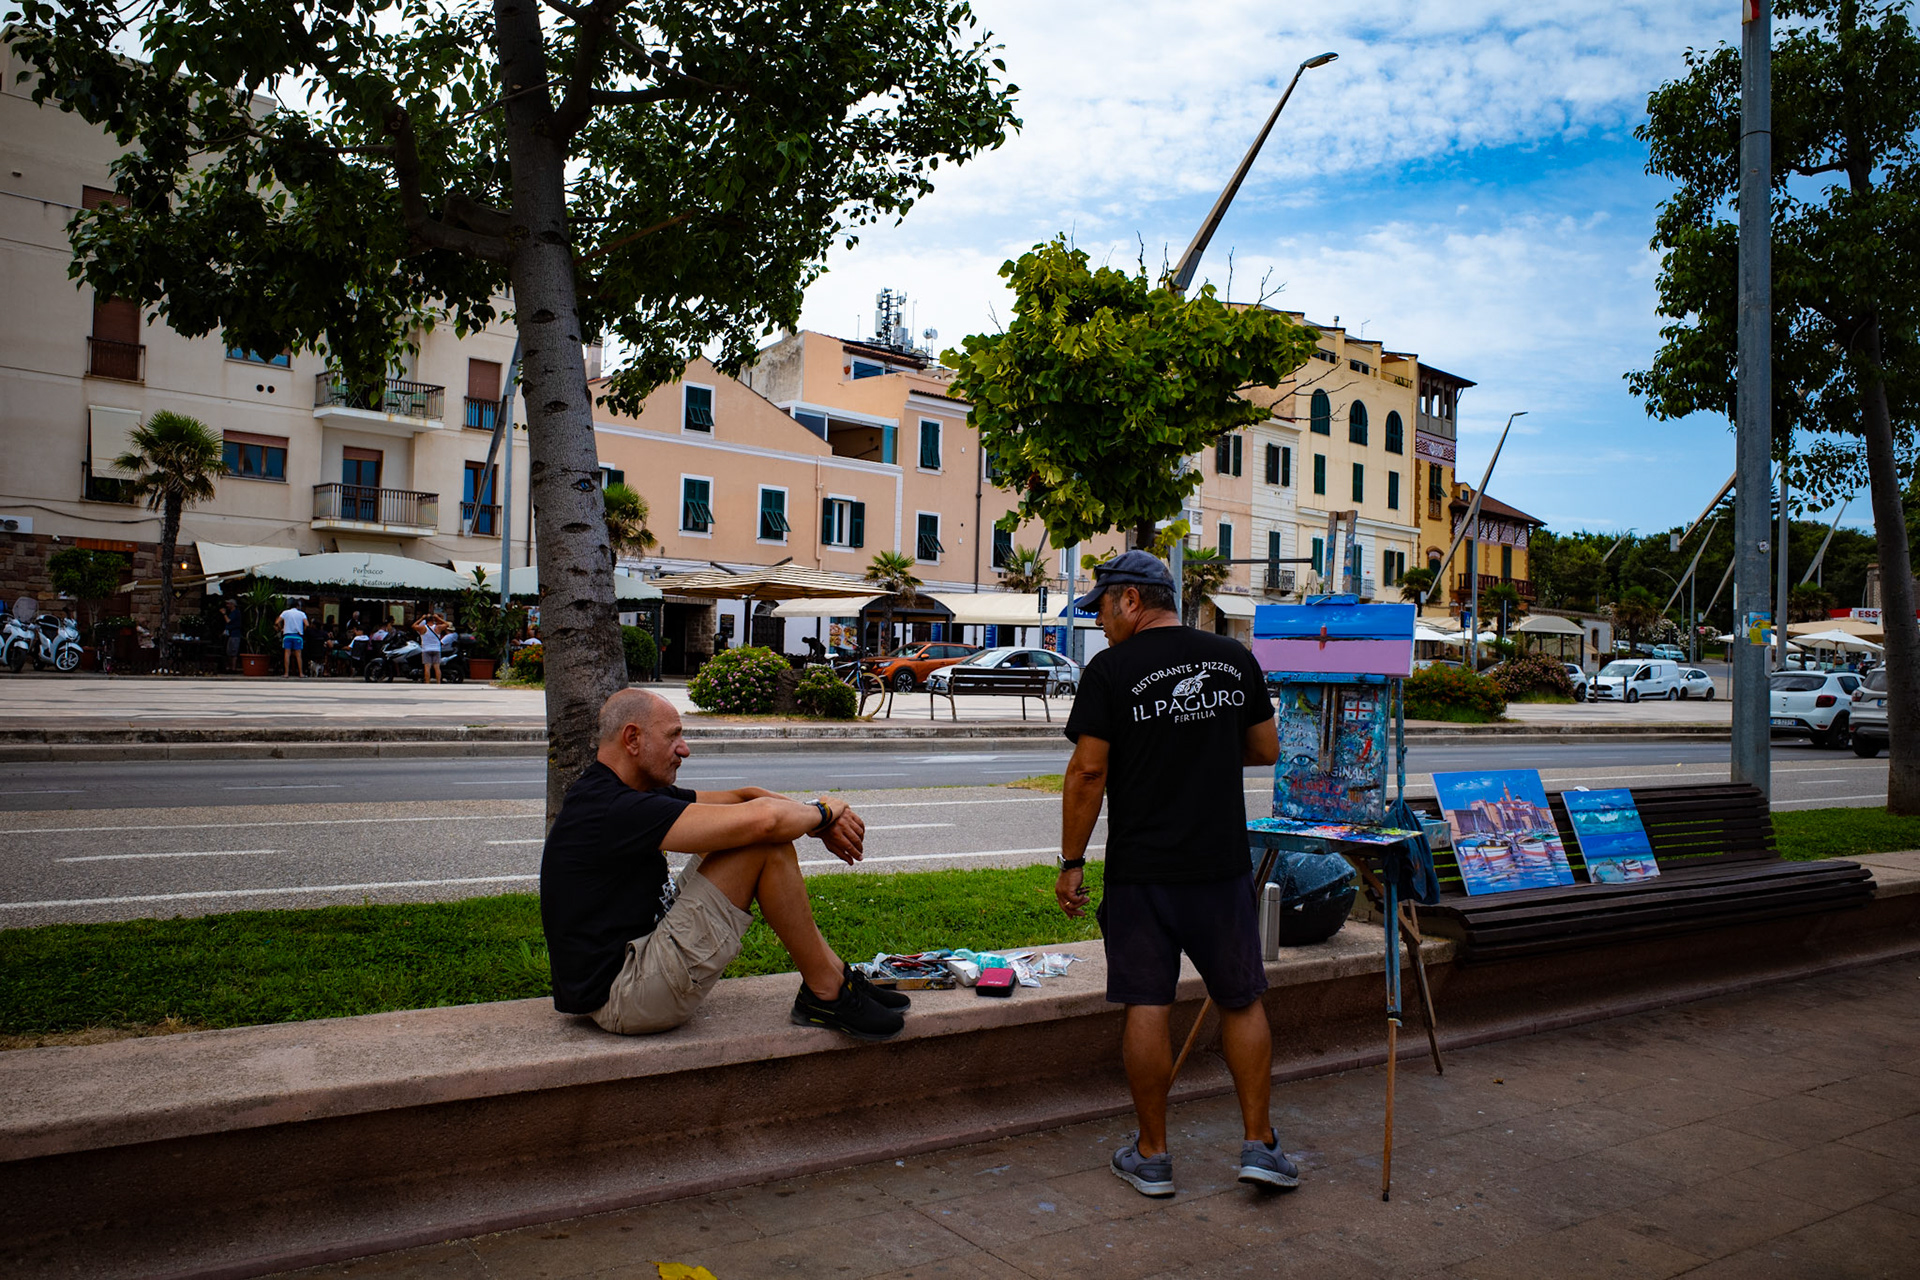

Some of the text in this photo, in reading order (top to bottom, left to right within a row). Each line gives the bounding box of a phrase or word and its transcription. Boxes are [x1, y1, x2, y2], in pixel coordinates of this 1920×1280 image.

[1858, 610, 1882, 618] ESS
[1131, 661, 1242, 695] RISTORANTE PIZZERIA
[1133, 690, 1245, 722] IL PAGURO
[1174, 709, 1216, 723] FERTILIA
